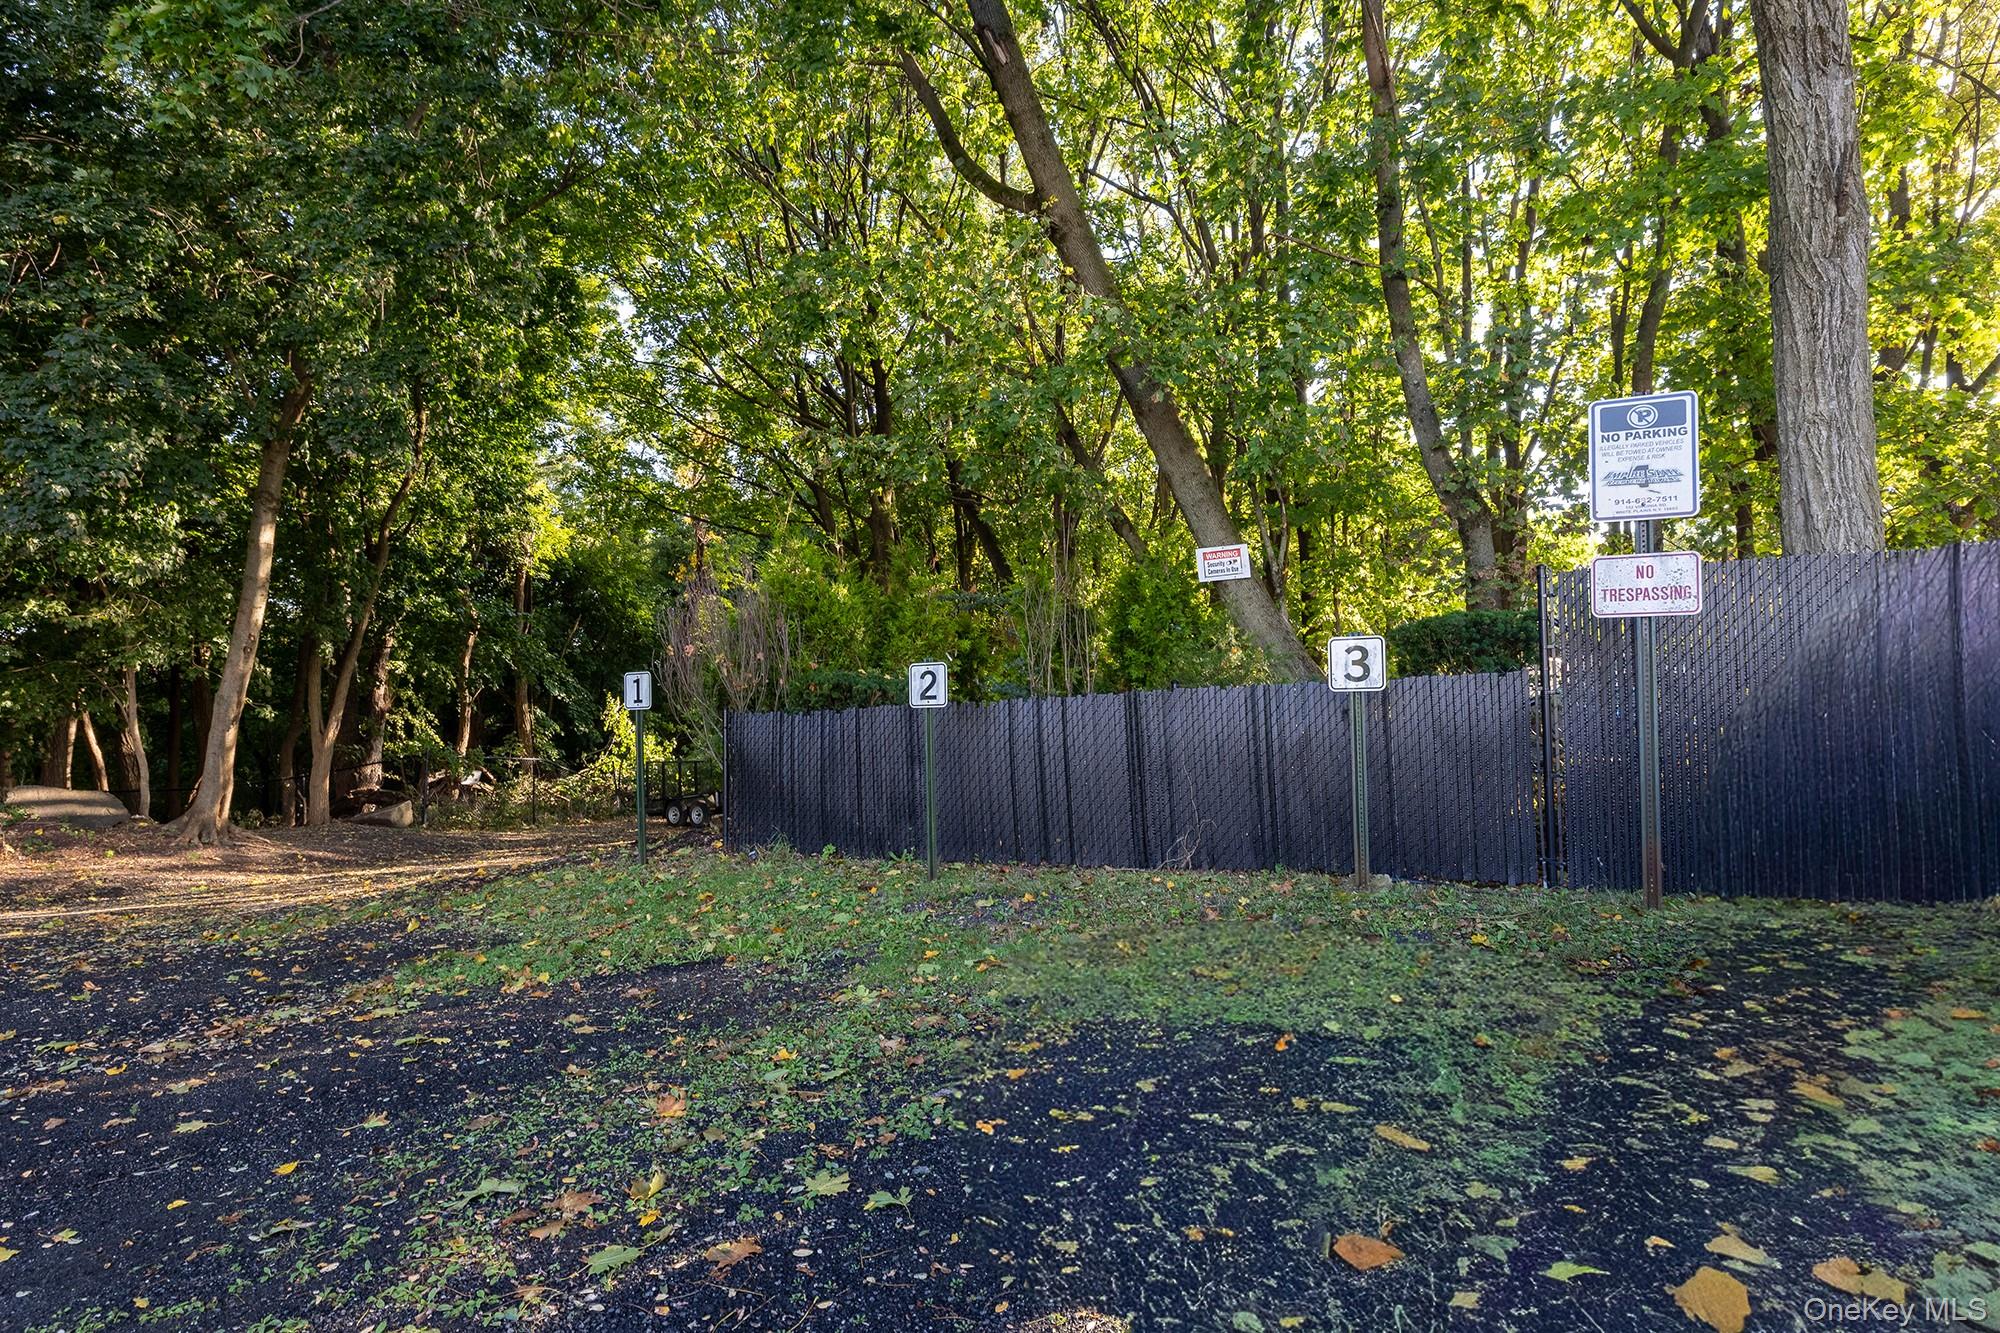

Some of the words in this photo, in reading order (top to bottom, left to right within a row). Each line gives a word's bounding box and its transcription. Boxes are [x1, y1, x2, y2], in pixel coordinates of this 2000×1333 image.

[1601, 433, 1620, 443] NO
[1625, 426, 1688, 441] PARKING
[1655, 438, 1684, 446] VEHICLES
[1206, 550, 1239, 560] WARNING
[1207, 560, 1225, 568] Security
[1636, 564, 1654, 579] NO
[1601, 585, 1692, 602] TRESPASSING
[1344, 645, 1370, 682] 3
[633, 678, 643, 703] 1
[920, 670, 937, 700] 2
